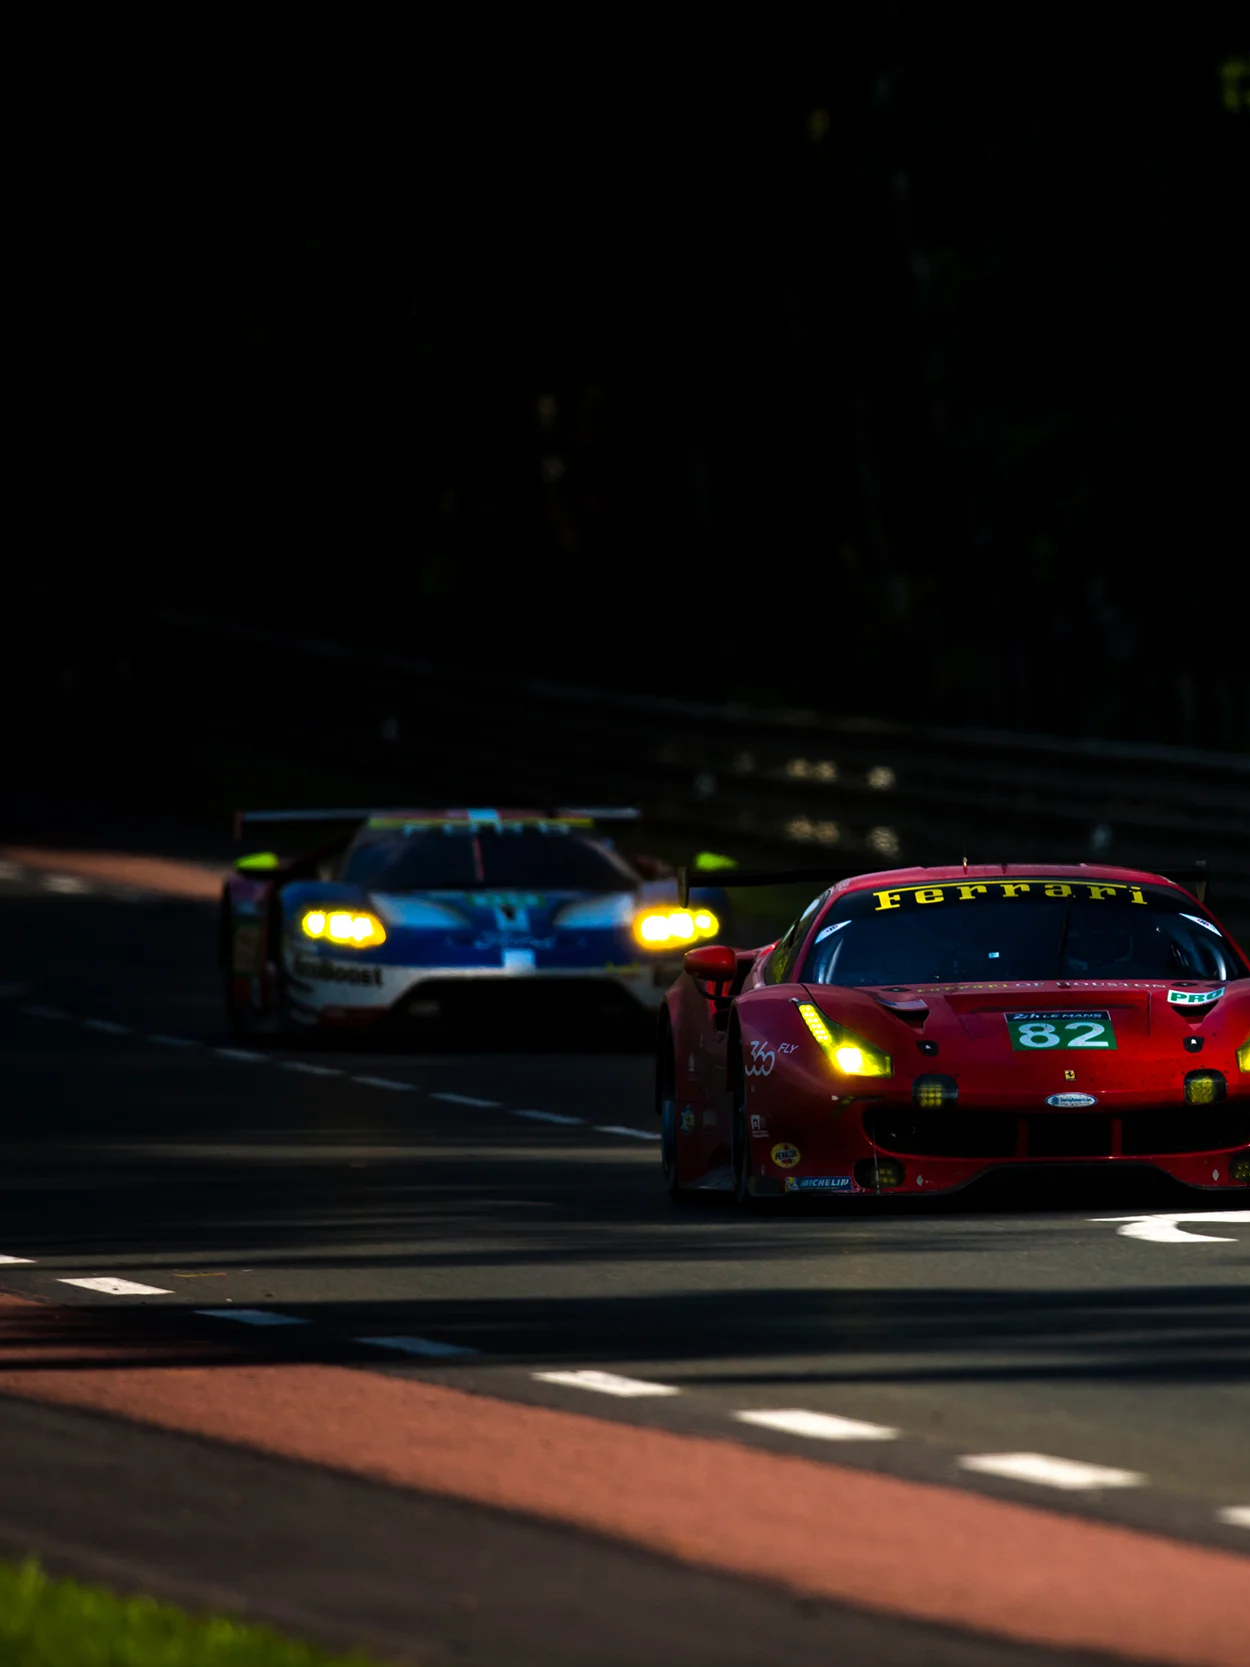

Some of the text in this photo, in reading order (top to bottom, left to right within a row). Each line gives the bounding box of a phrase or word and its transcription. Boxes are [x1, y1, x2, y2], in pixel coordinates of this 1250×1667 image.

[873, 880, 1148, 911] Ferrari
[1171, 989, 1222, 1002] PRO
[1018, 1022, 1110, 1048] 82
[778, 1043, 799, 1054] FLY
[800, 1178, 851, 1188] MICHELIN
